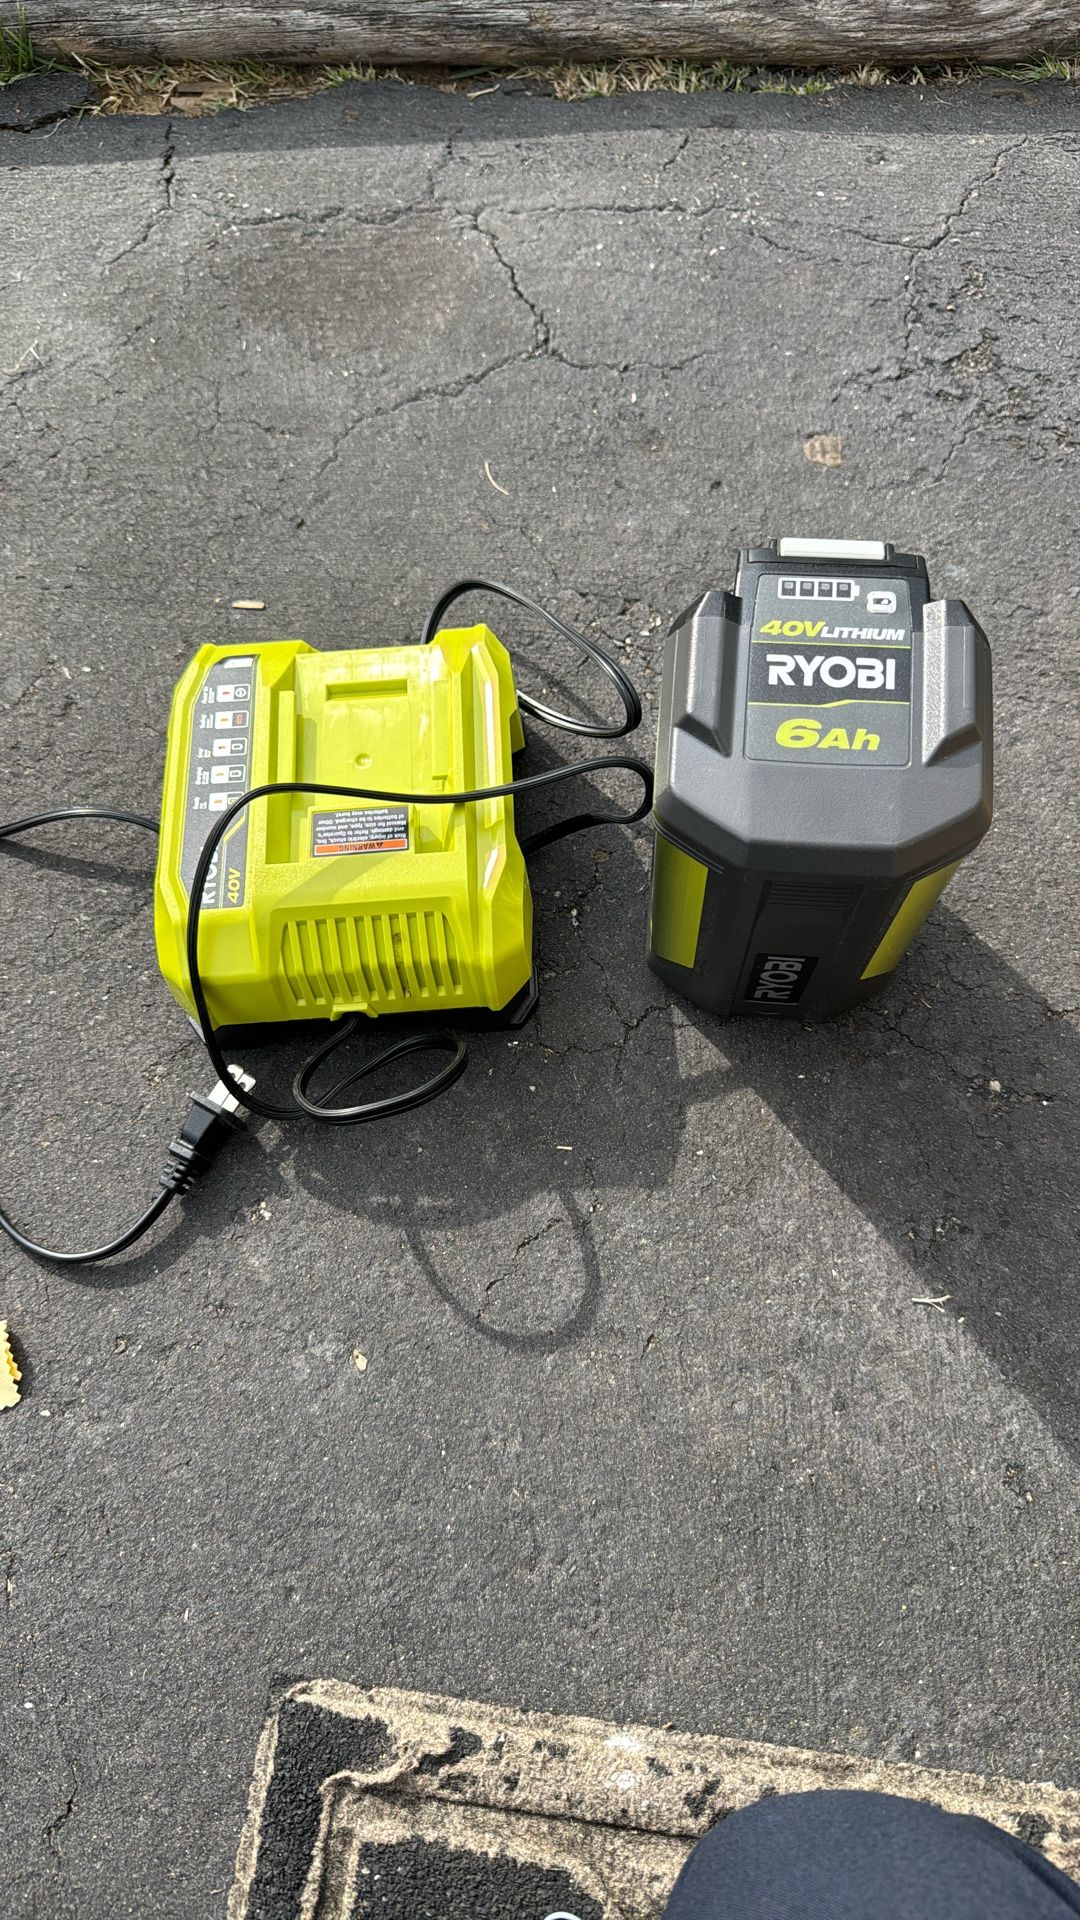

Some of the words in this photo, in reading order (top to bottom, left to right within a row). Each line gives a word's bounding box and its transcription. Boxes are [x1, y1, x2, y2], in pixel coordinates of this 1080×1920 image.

[759, 620, 826, 637] 40V
[820, 626, 906, 641] LITHIUM
[766, 654, 896, 690] RYOBI
[775, 718, 881, 751] 6Ah
[339, 843, 375, 851] WARNING
[200, 845, 219, 904] RYO
[227, 867, 241, 904] 40V
[754, 956, 806, 999] RYOBI
